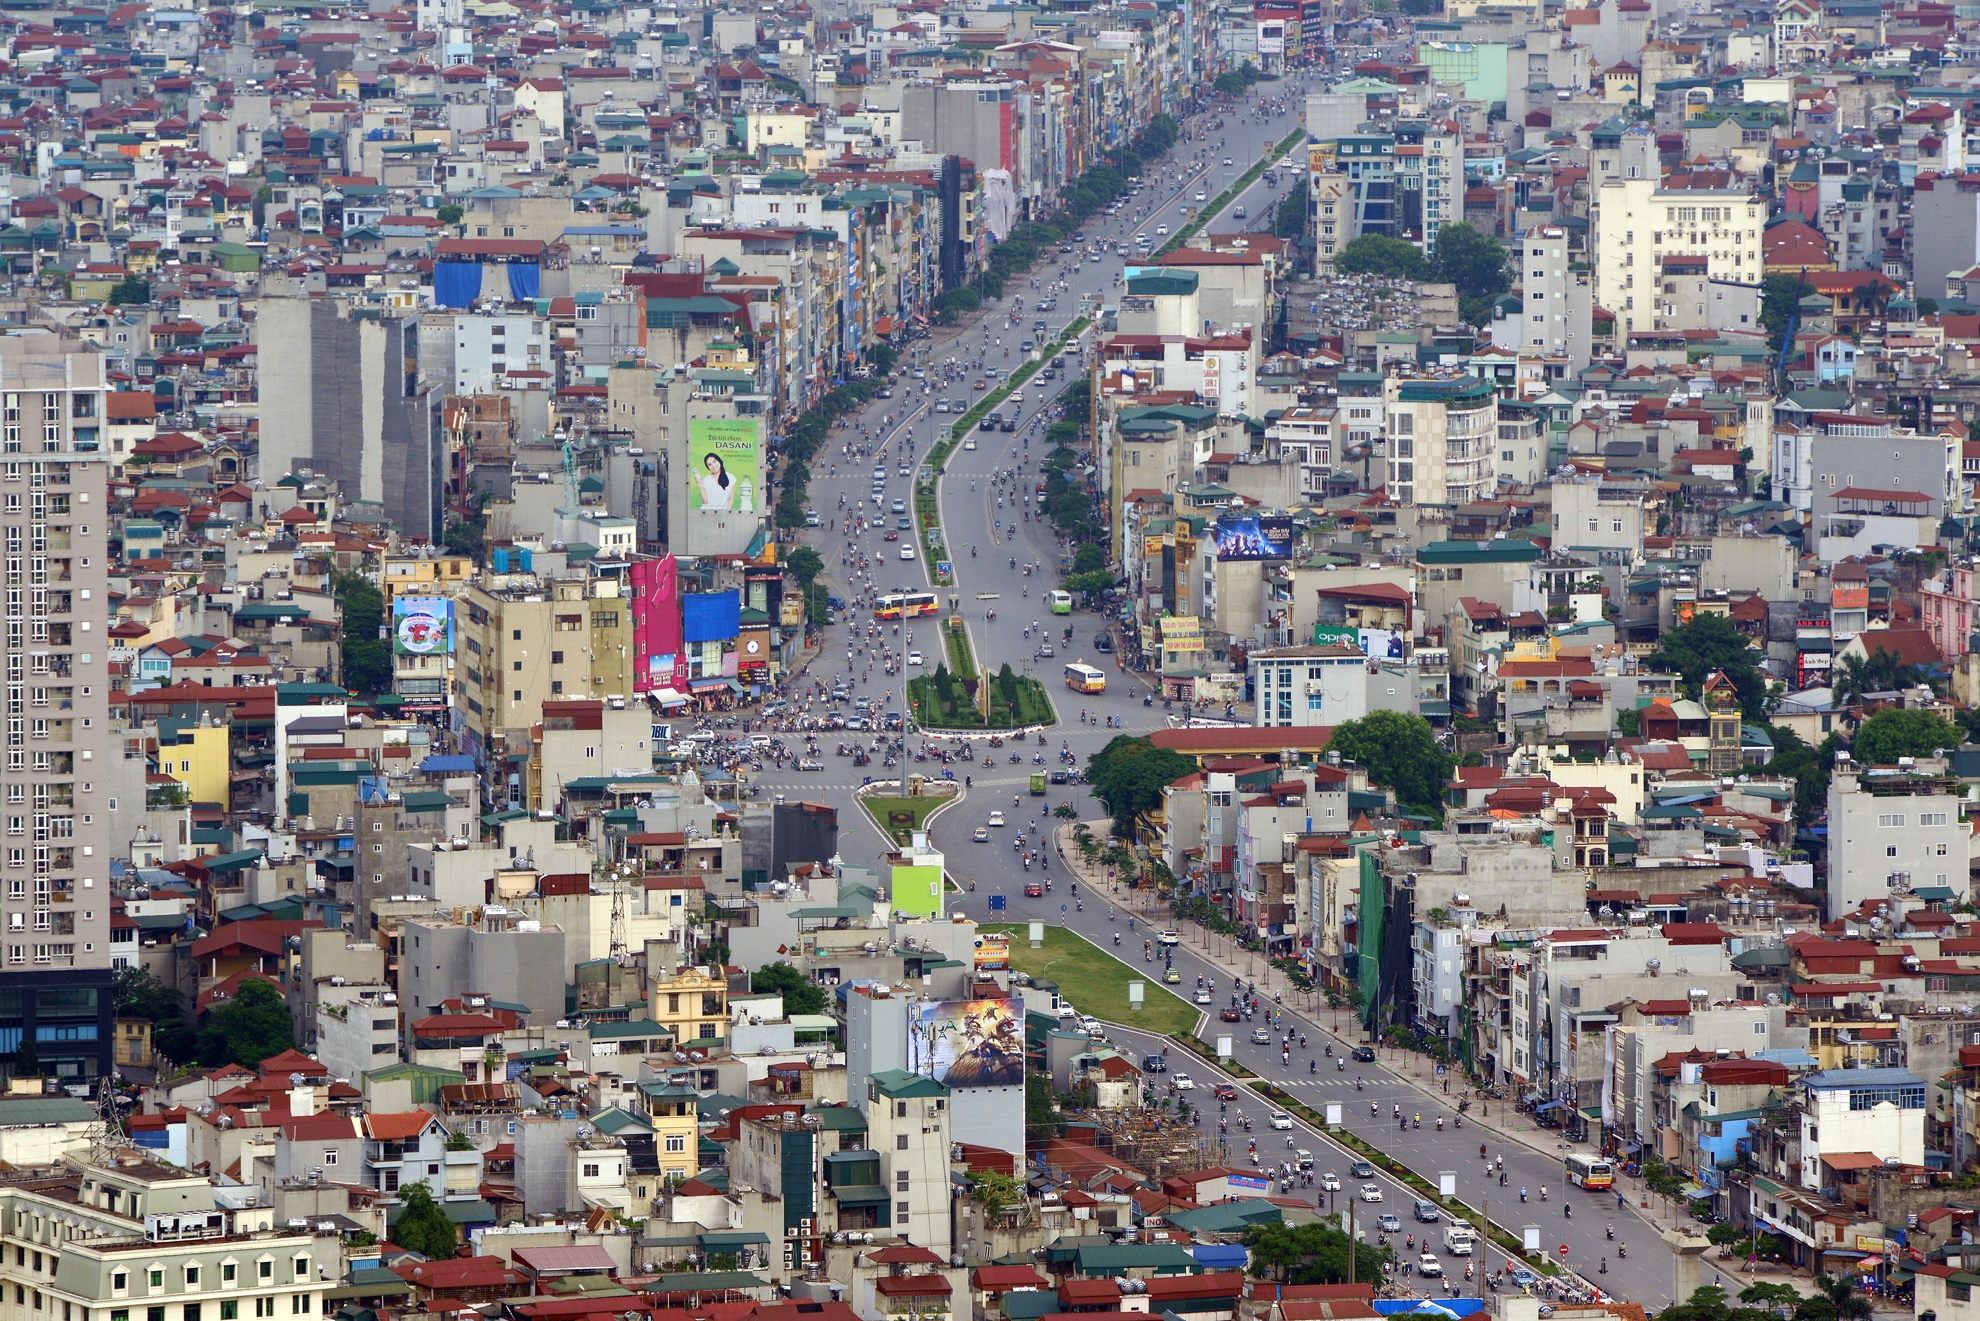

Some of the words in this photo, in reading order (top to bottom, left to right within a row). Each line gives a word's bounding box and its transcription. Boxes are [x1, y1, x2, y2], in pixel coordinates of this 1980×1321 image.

[1204, 388, 1218, 397] HOTEL
[715, 441, 752, 449] DASANI
[915, 1020, 957, 1033] NIJA
